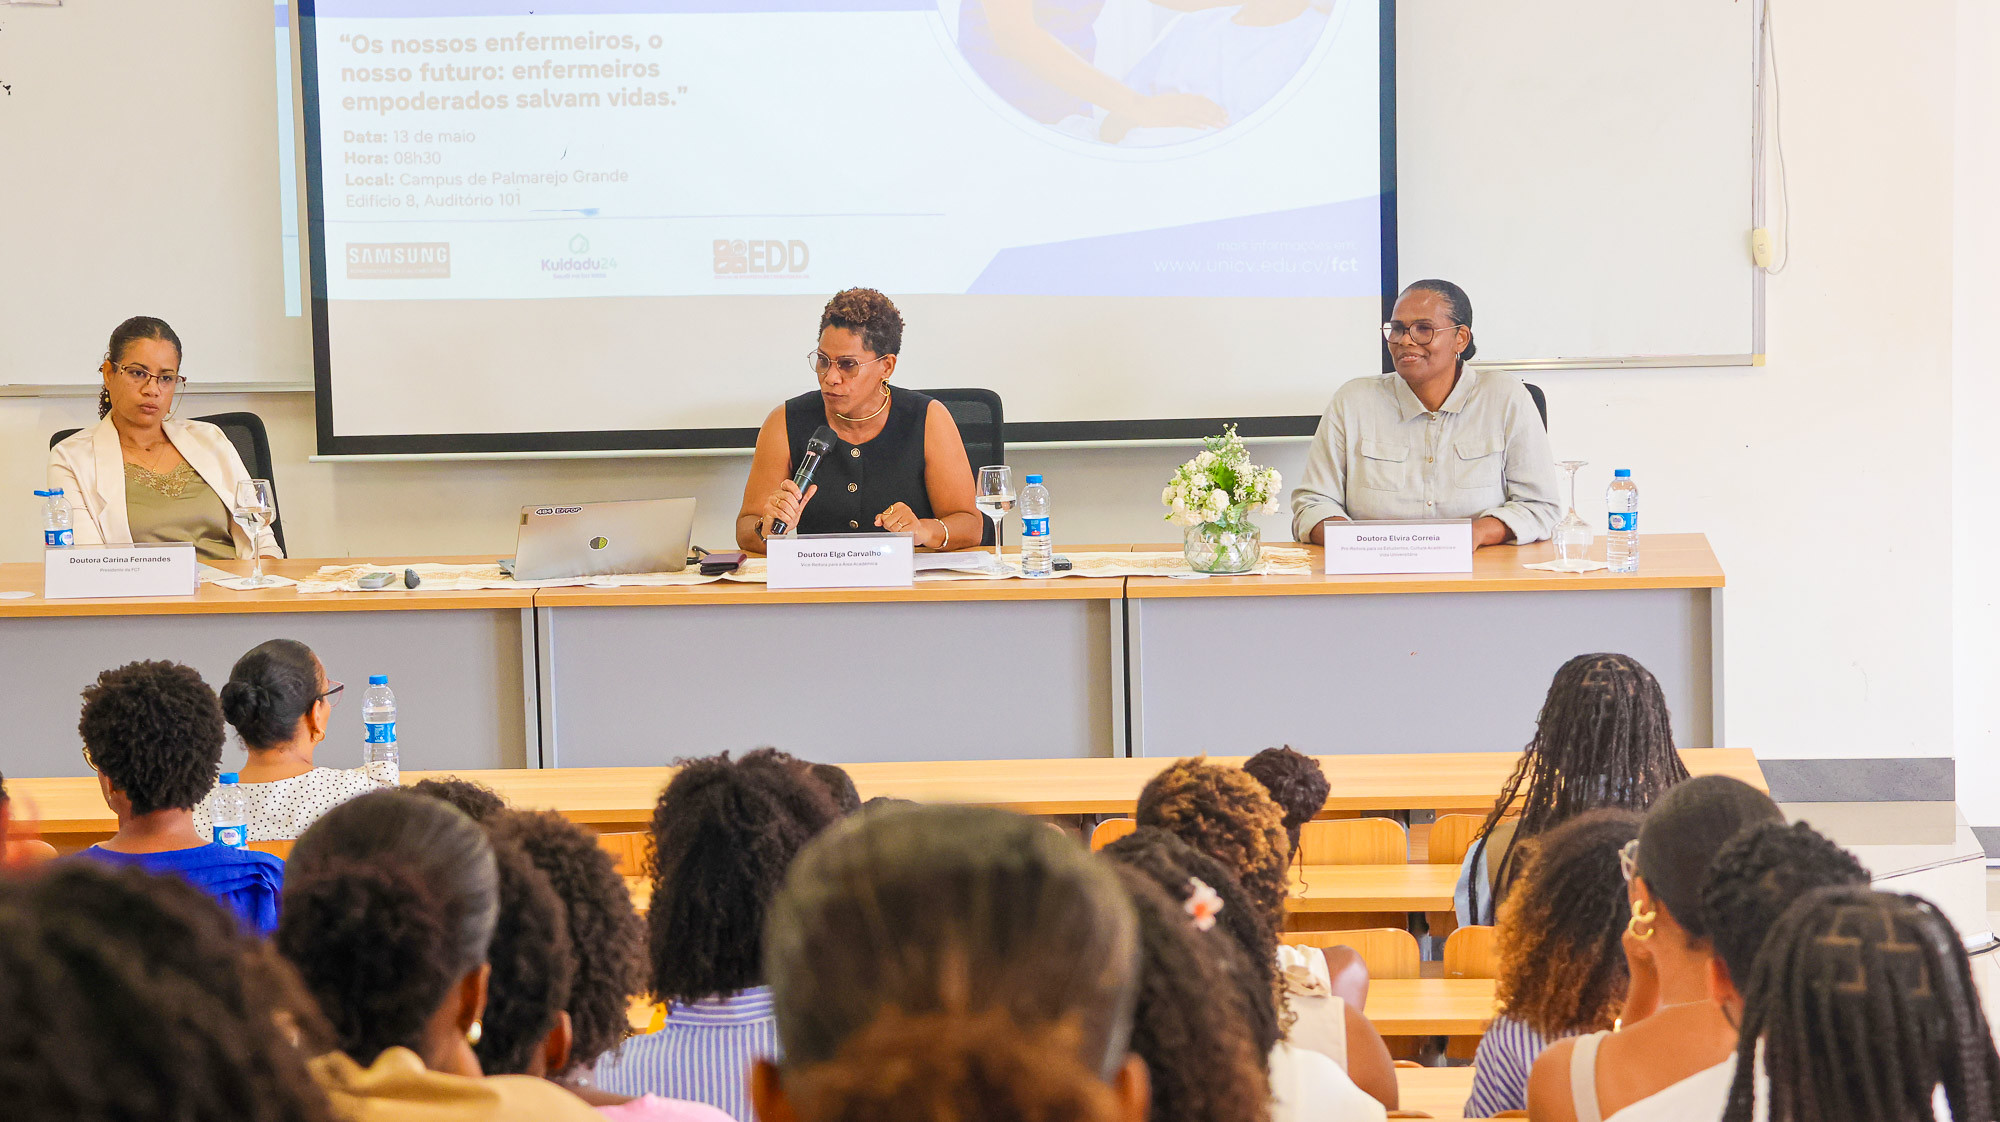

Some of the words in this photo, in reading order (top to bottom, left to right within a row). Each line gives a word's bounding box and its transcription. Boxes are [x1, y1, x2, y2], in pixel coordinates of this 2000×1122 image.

[392, 36, 477, 54] nossos
[486, 30, 640, 53] enfermeiros,
[648, 34, 663, 49] o
[342, 64, 412, 82] nosso
[420, 61, 504, 82] futuro:
[512, 59, 659, 80] enfermeiros
[342, 89, 508, 115] empoderados
[516, 88, 600, 109] salvam
[607, 86, 688, 107] vidas.”
[343, 130, 387, 144] Data:
[393, 130, 408, 143] 13
[414, 129, 433, 143] de
[439, 129, 475, 143] maio
[344, 151, 389, 165] Hora:
[394, 151, 441, 165] 08h30
[345, 173, 394, 187] Local:
[399, 171, 462, 188] Campus
[468, 171, 487, 186] de
[492, 170, 568, 188] Palmarejo
[573, 169, 629, 183] Grande
[346, 193, 401, 208] Edifício
[406, 193, 419, 210] 8,
[424, 191, 493, 207] Auditório
[499, 192, 521, 206] 101
[349, 247, 447, 264] SAMSUNG
[541, 257, 617, 271] Kuidadu24
[748, 240, 810, 273] EDD
[1153, 256, 1359, 274] www.unicv.edu.cv/fct
[829, 551, 846, 559] Elga
